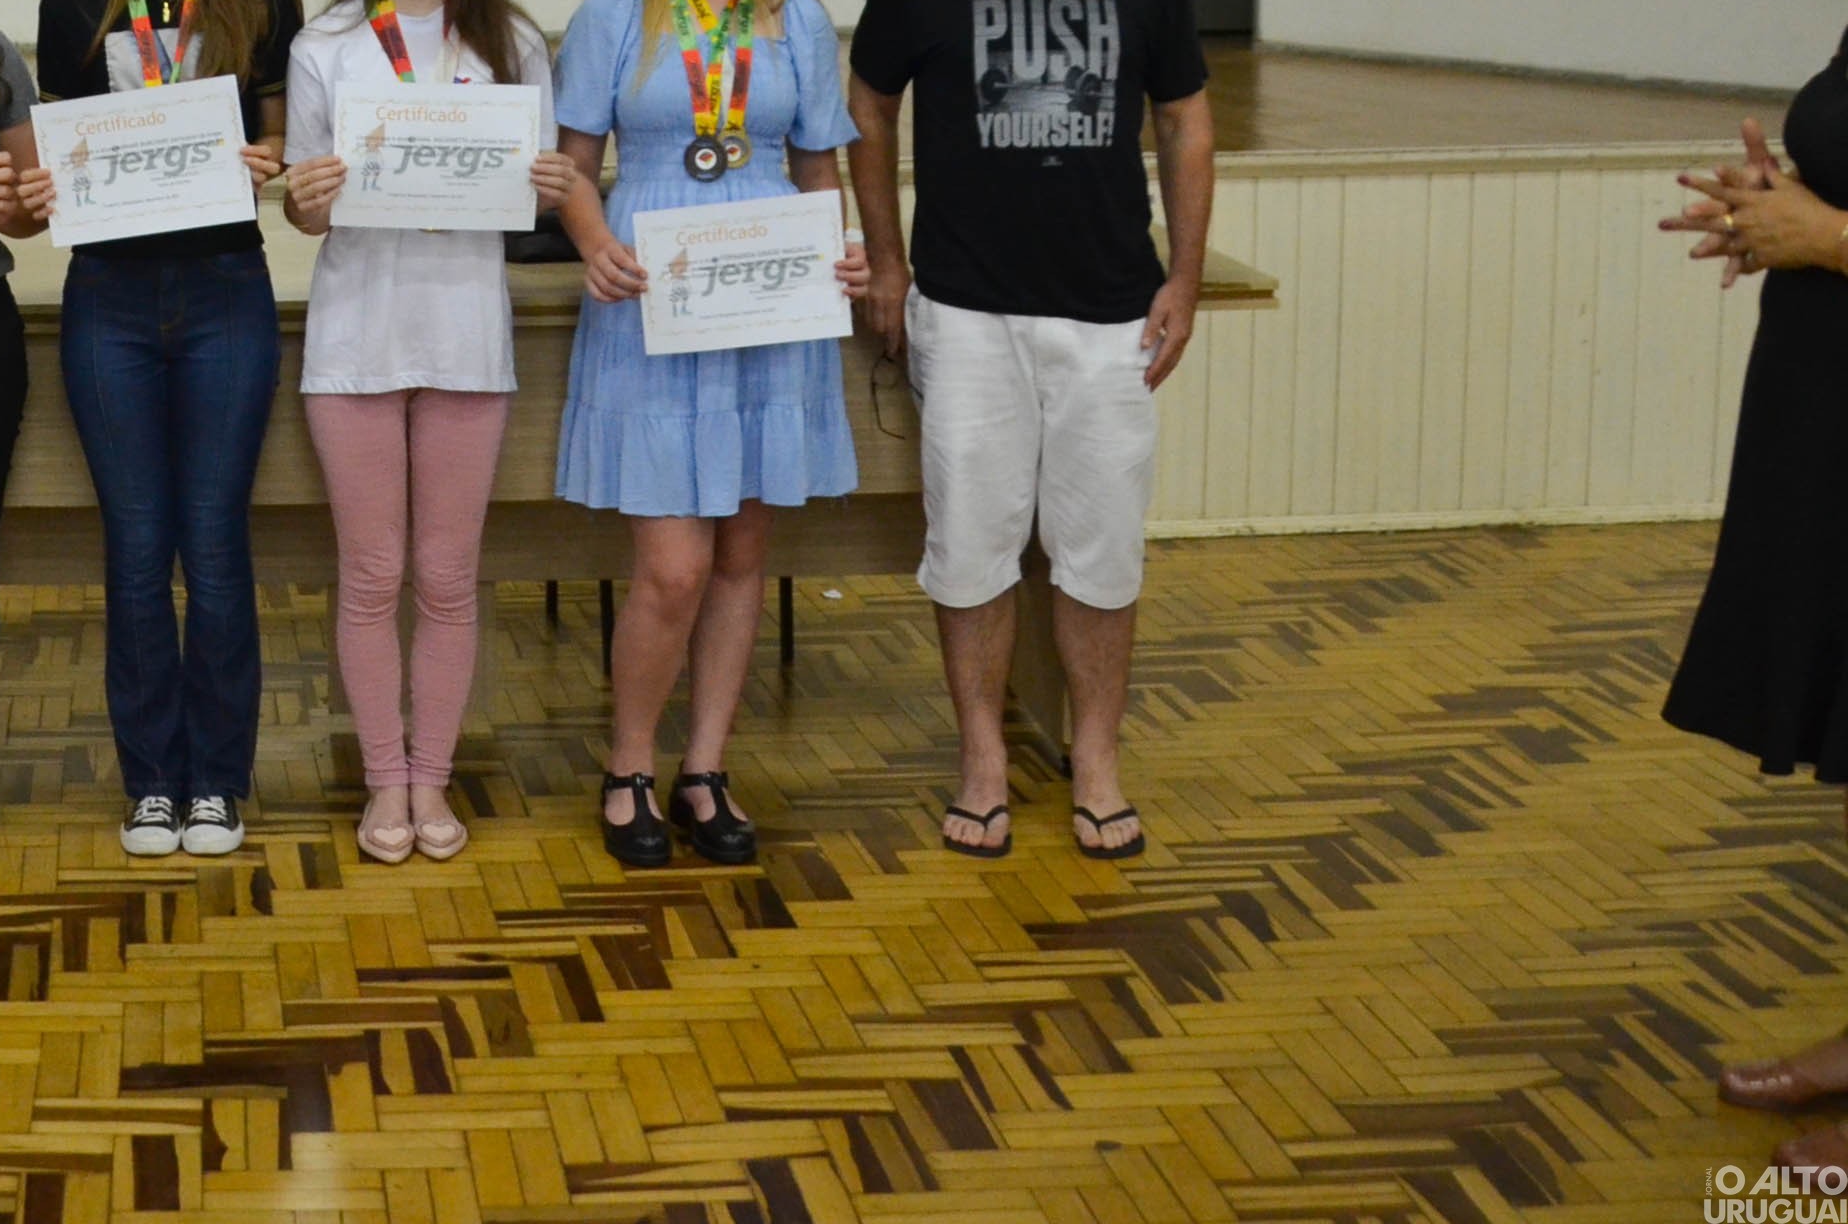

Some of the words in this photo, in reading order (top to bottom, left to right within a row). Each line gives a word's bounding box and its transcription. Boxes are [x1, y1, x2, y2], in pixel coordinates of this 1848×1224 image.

[75, 112, 167, 137] Certificado
[376, 105, 468, 122] Certificado
[976, 111, 1115, 149] YOURSELF!
[100, 140, 214, 185] jergs
[393, 136, 506, 177] jergs
[676, 224, 768, 246] Certificado
[699, 256, 812, 297] jergs
